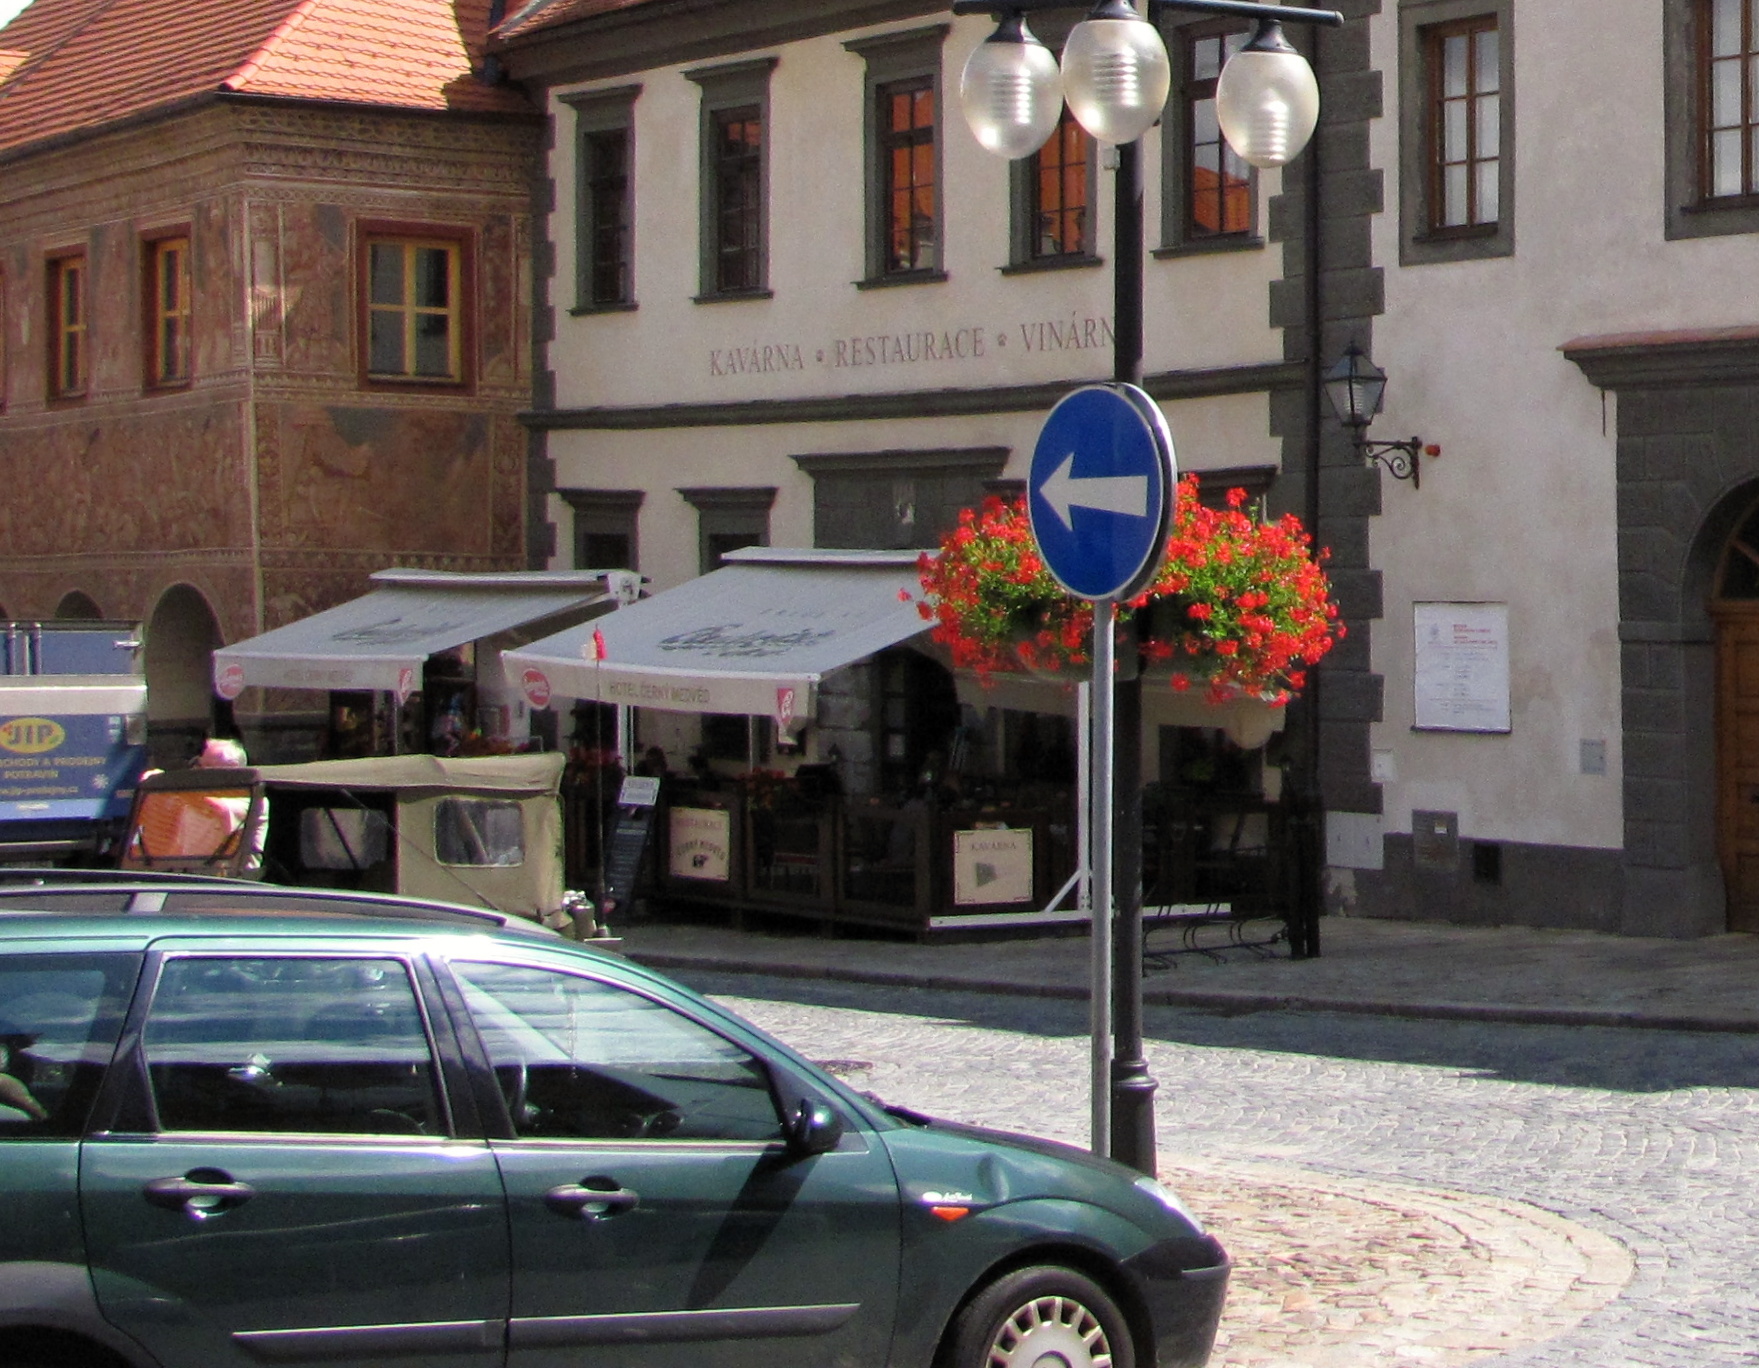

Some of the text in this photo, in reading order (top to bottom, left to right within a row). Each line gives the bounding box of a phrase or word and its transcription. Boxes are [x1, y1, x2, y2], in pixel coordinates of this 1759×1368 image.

[709, 311, 1115, 377] KAVÁRNA RESTAURACE VINÁRN
[8, 724, 54, 745] JIP
